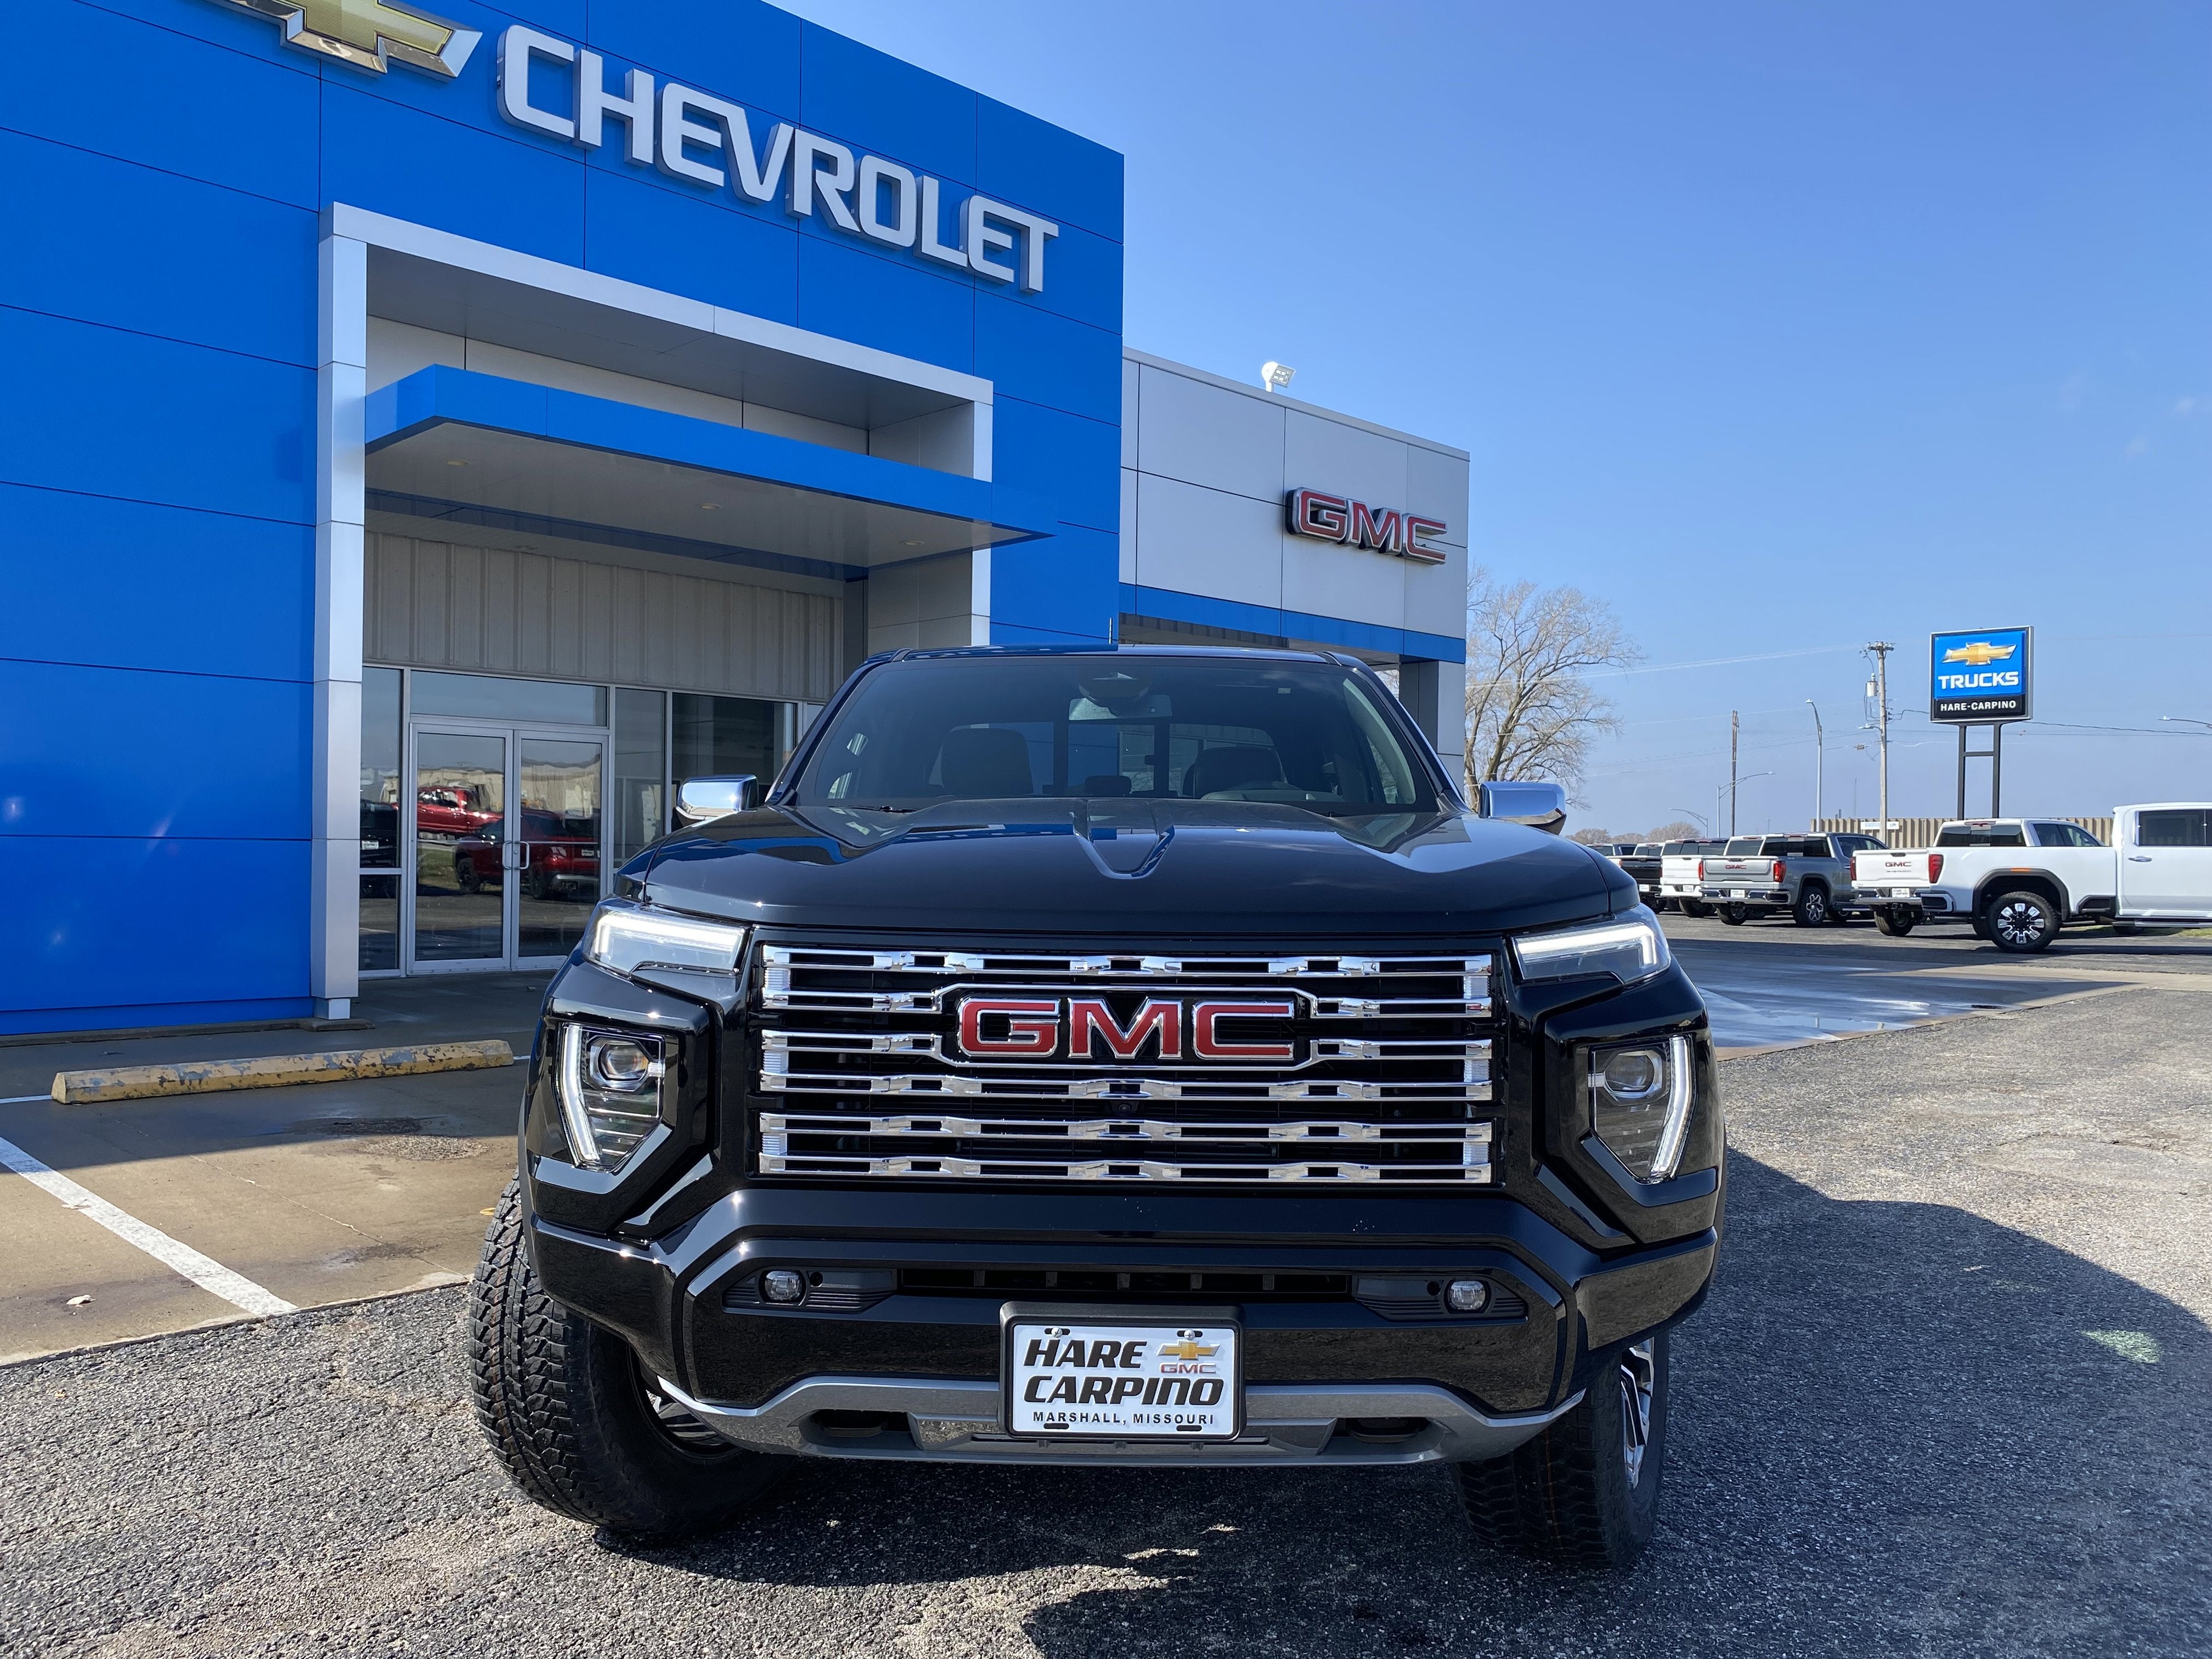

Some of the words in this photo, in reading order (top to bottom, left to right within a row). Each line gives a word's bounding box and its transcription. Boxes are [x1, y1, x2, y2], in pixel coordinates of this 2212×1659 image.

[496, 25, 1058, 294] CHEVROLET
[1286, 487, 1447, 565] GMC
[1938, 671, 2019, 689] TRUCKS
[1940, 700, 2016, 711] HARE-CARPINO
[957, 996, 1295, 1060] GMC
[1023, 1339, 1147, 1368] HARE
[1160, 1363, 1217, 1374] GMC
[1024, 1376, 1224, 1406] CARPINO
[1033, 1412, 1126, 1426] MARSHALL,
[1133, 1413, 1214, 1425] MISSOURI
